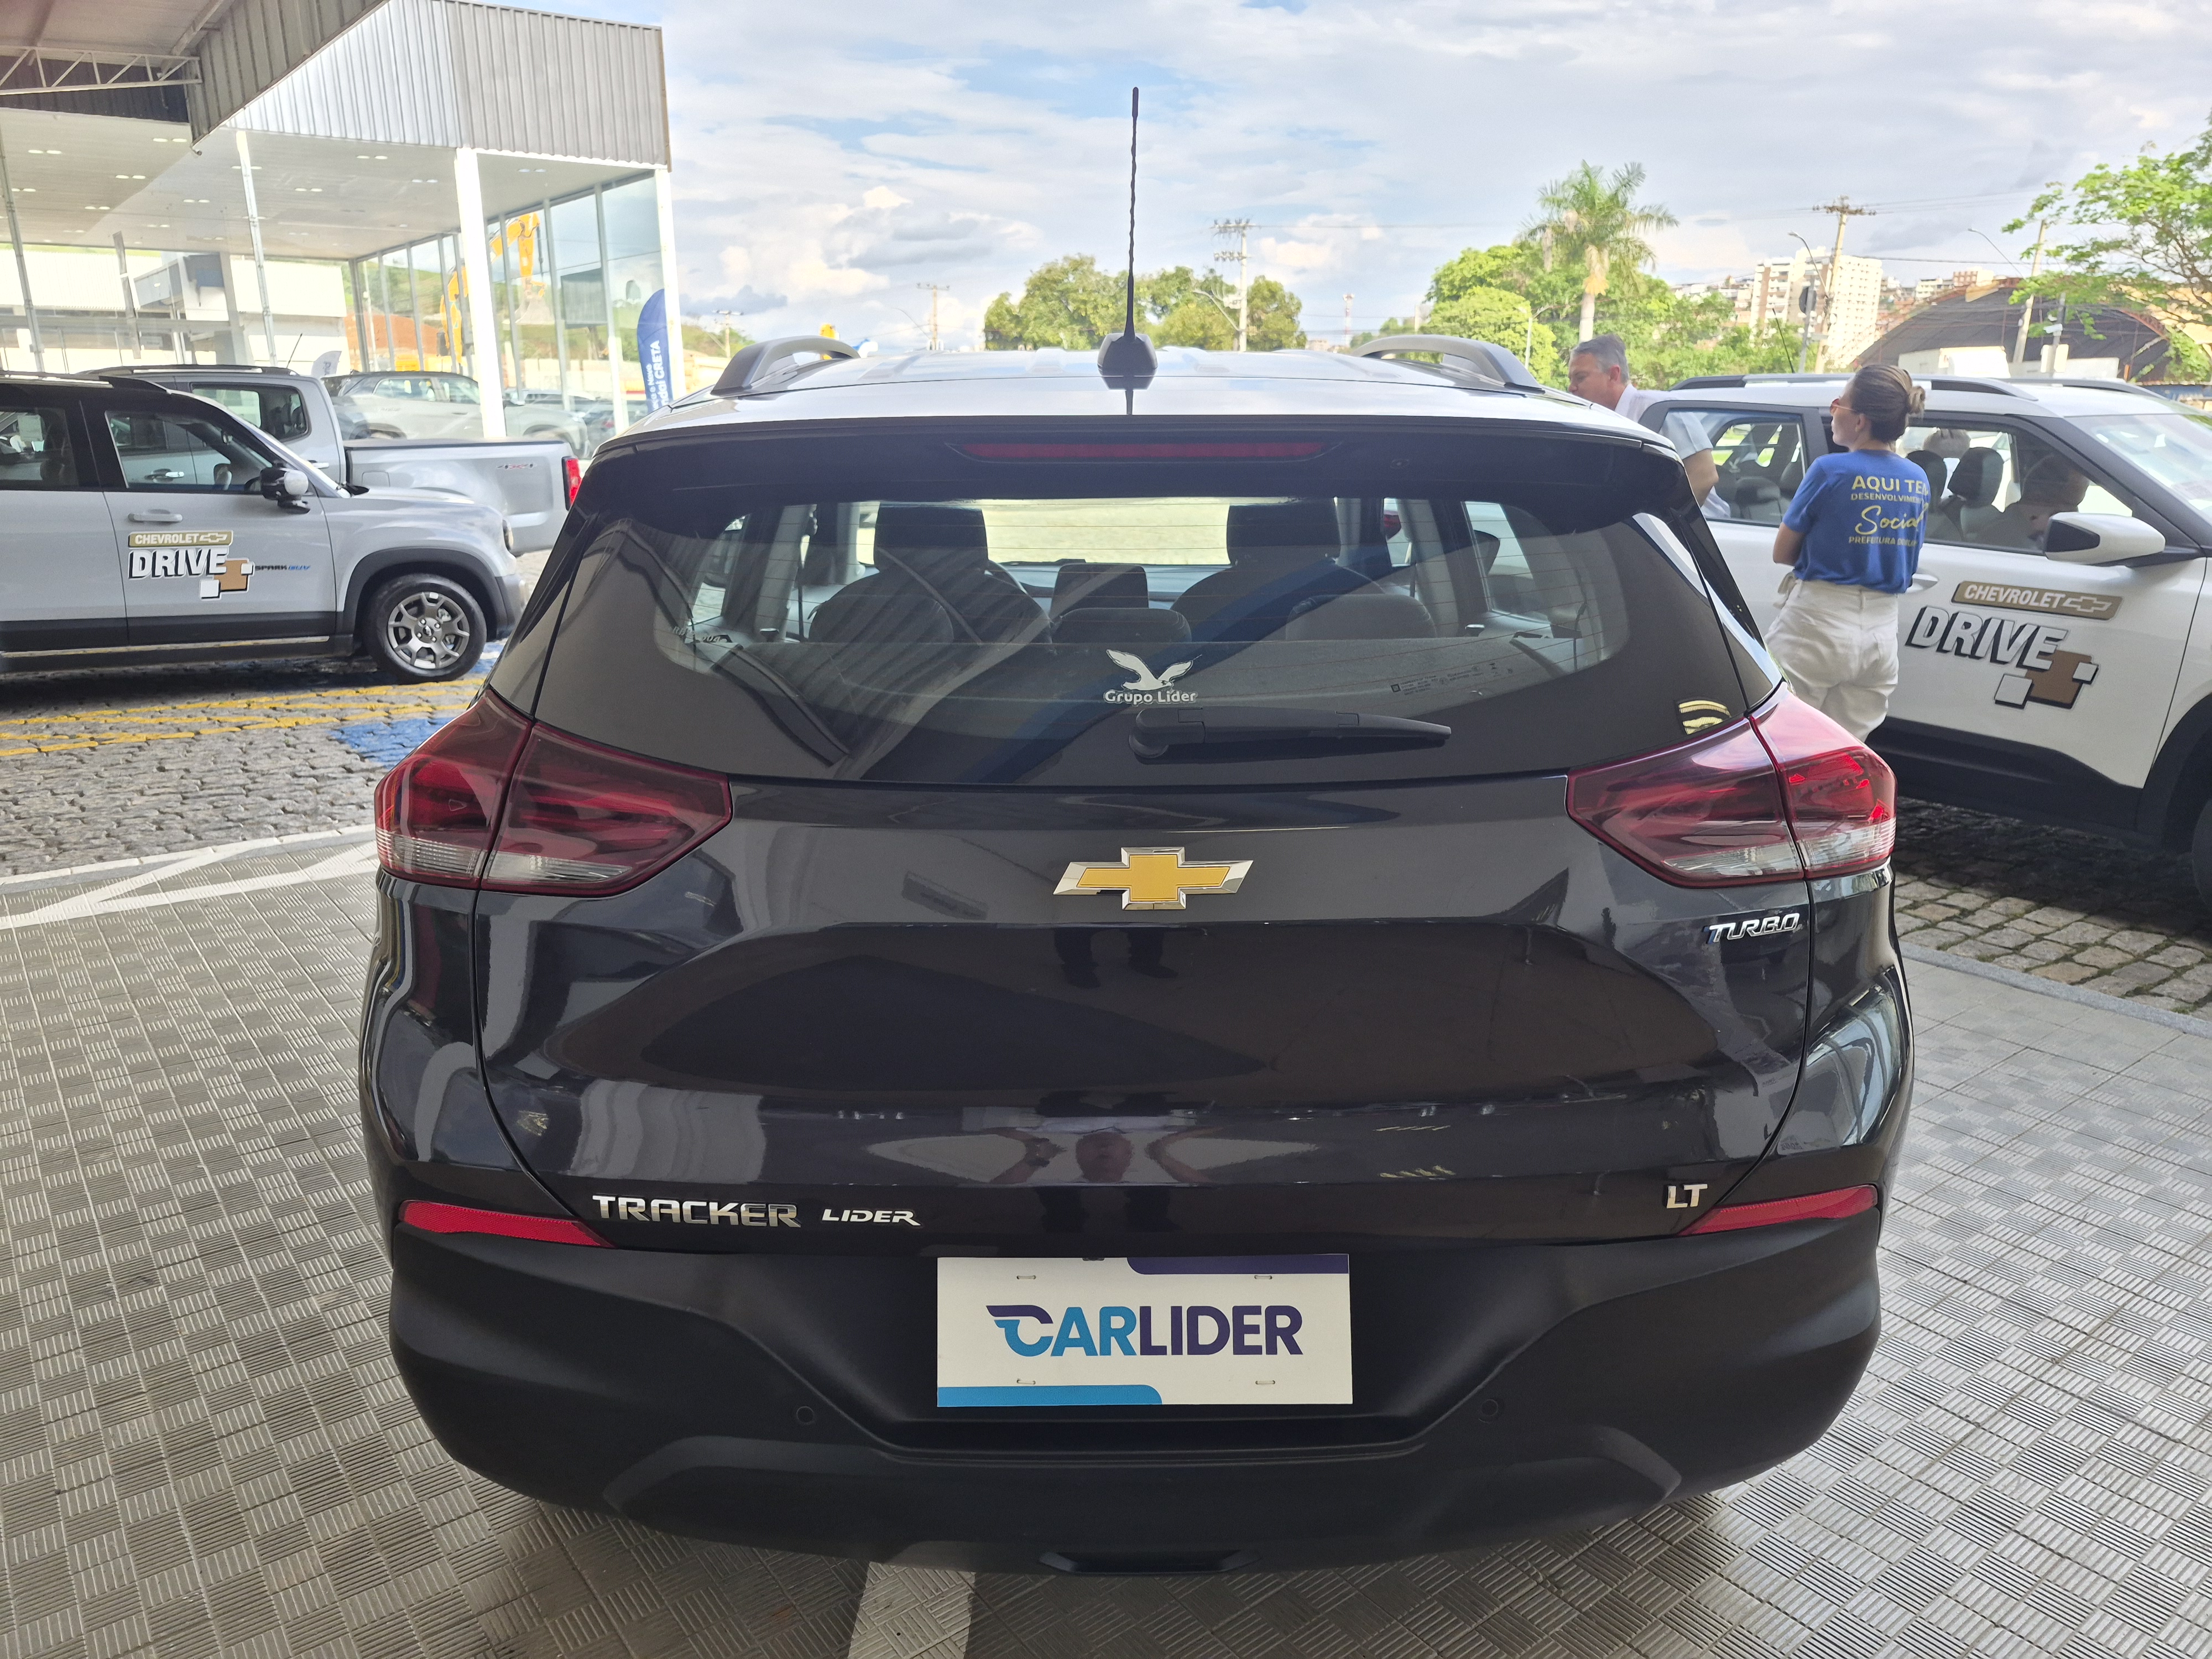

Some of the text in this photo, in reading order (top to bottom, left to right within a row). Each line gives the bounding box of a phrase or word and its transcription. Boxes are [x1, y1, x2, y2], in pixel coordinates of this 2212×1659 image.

[650, 340, 665, 379] CRETA
[1851, 476, 1900, 492] AQUI
[135, 534, 199, 544] CHEVROLET
[1849, 536, 1896, 545] PREFEITURA
[129, 549, 228, 578] DRIVE
[1964, 585, 2065, 608] CHEVROLET
[1906, 606, 2070, 672] DRIVE
[1105, 691, 1153, 705] Grupo
[1704, 913, 1800, 945] TURBO
[1666, 1183, 1708, 1209] LT
[592, 1194, 921, 1228] TRACKER LIDER
[985, 1305, 1303, 1357] CARLIDER
